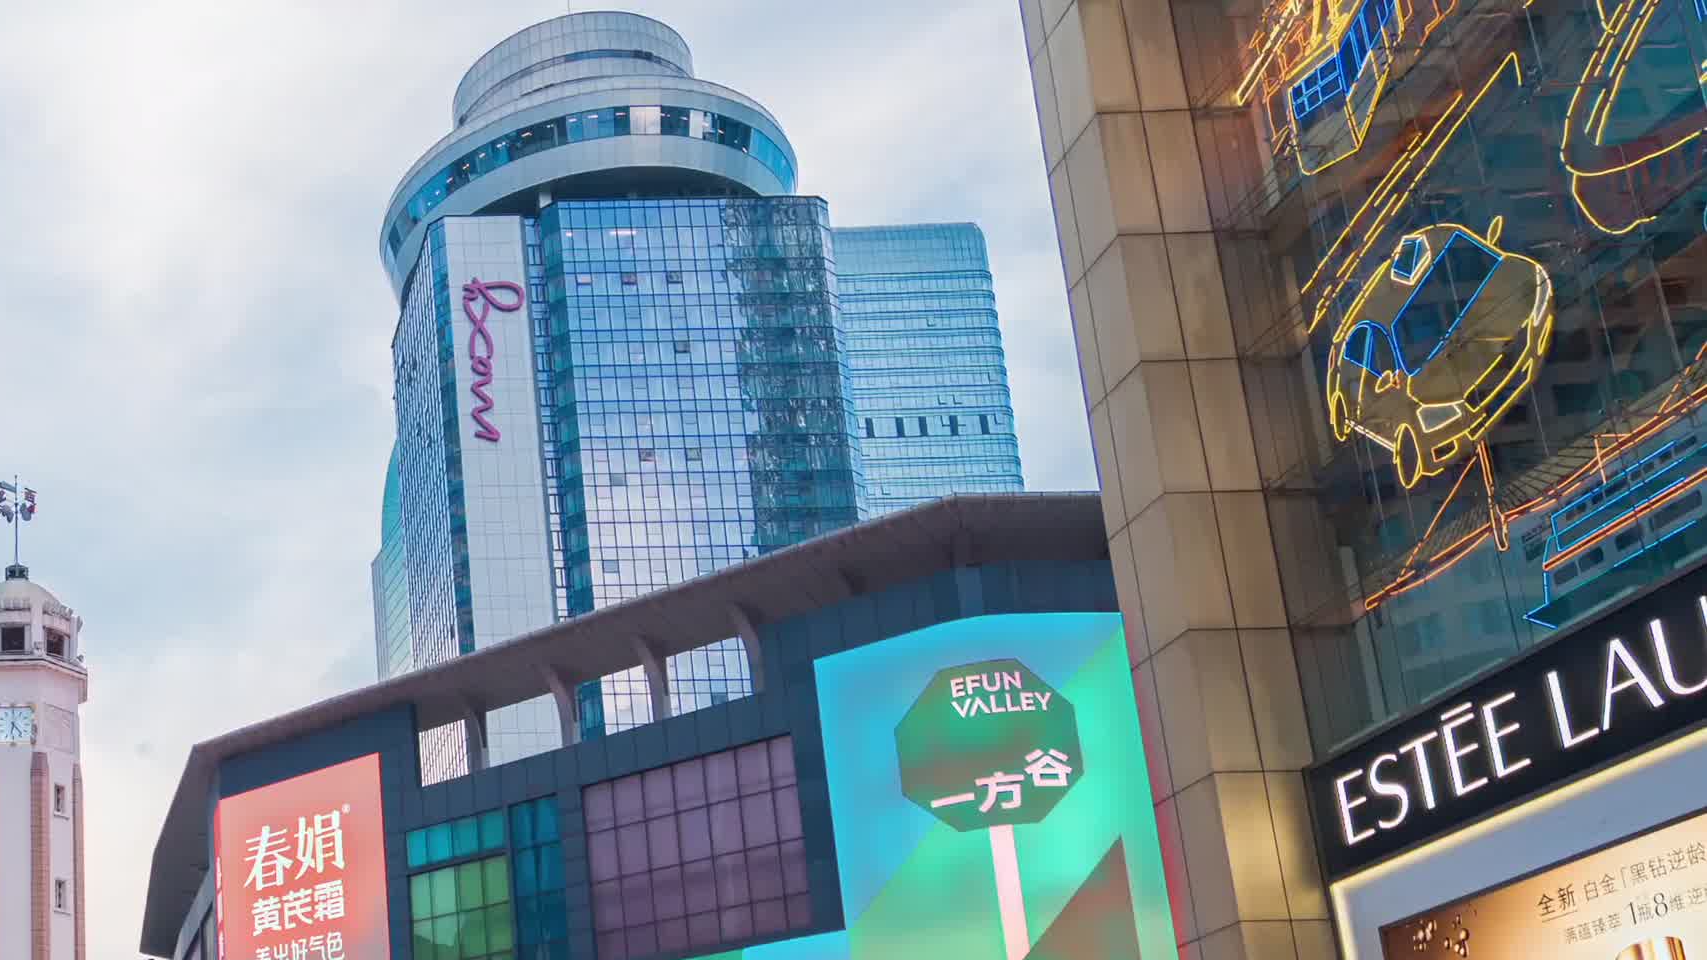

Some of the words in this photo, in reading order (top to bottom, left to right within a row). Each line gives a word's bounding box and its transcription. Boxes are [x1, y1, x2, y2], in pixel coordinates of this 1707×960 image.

[950, 671, 1023, 698] EFUN
[951, 691, 1052, 718] VALLEY
[930, 748, 1073, 813] 一方谷
[244, 809, 346, 891] 春娟
[250, 879, 346, 936] 黄芪霜
[1537, 883, 1577, 917] 全新
